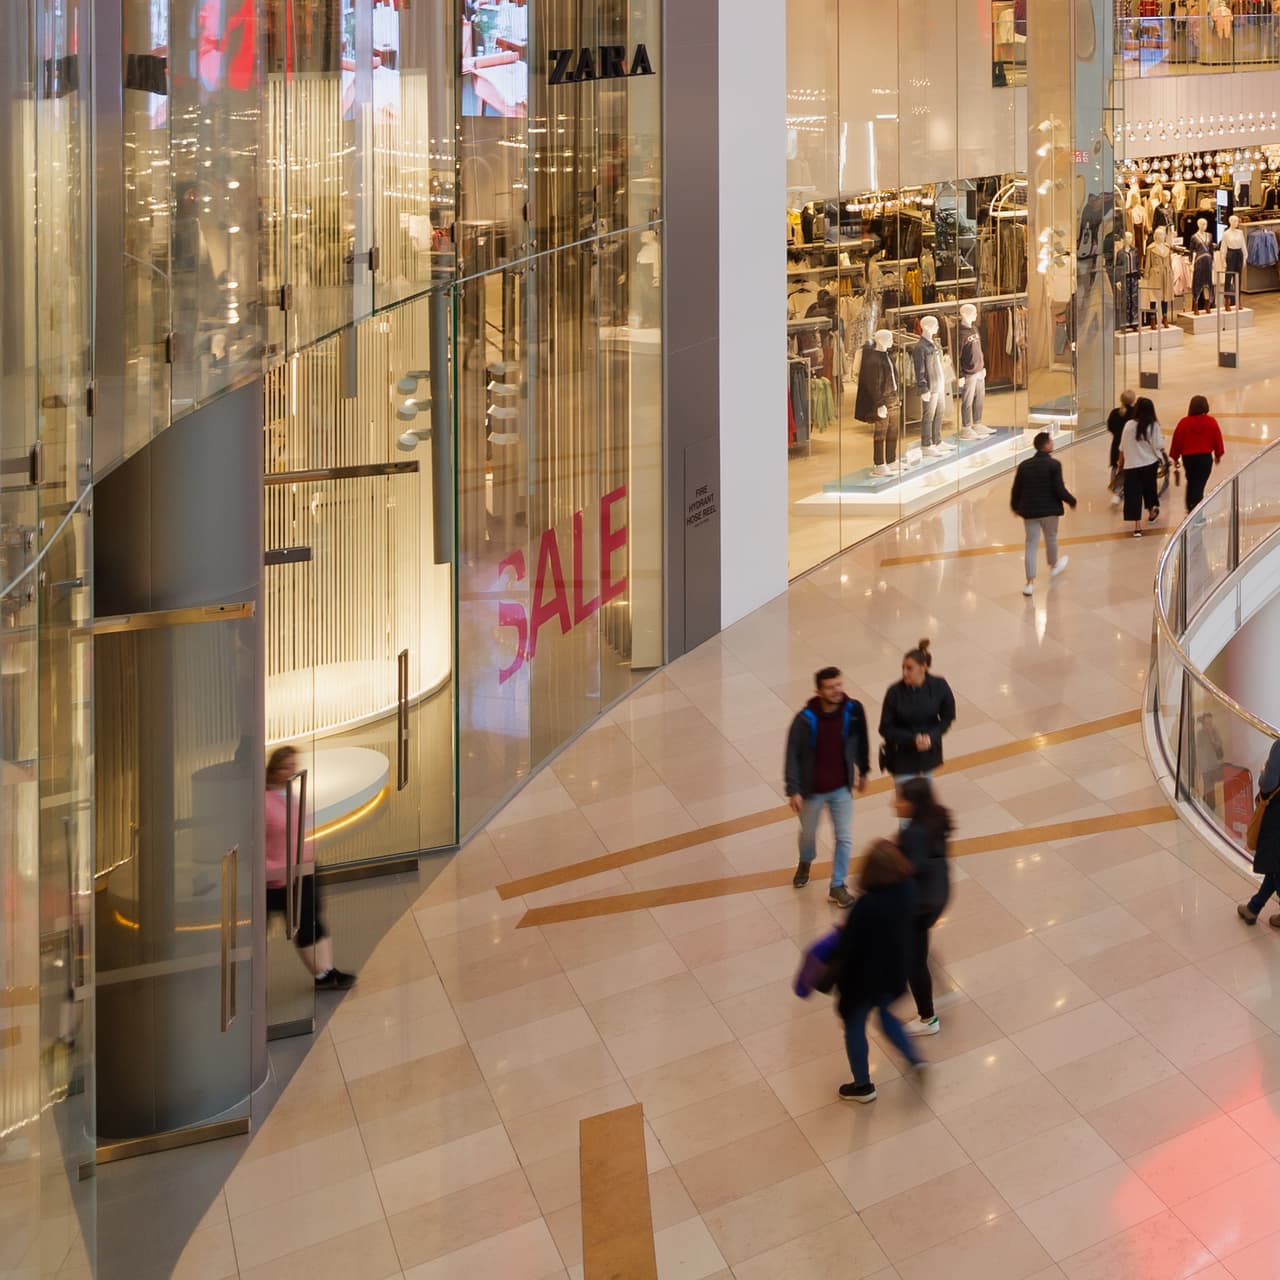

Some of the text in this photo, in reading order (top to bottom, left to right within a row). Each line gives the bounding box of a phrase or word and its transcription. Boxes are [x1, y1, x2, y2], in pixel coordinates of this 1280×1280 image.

[548, 44, 656, 85] ZARA
[688, 492, 714, 513] HYDRANT
[696, 484, 708, 498] FIRE
[686, 511, 702, 528] HOSE
[703, 504, 717, 518] REEL
[498, 484, 628, 686] SALE
